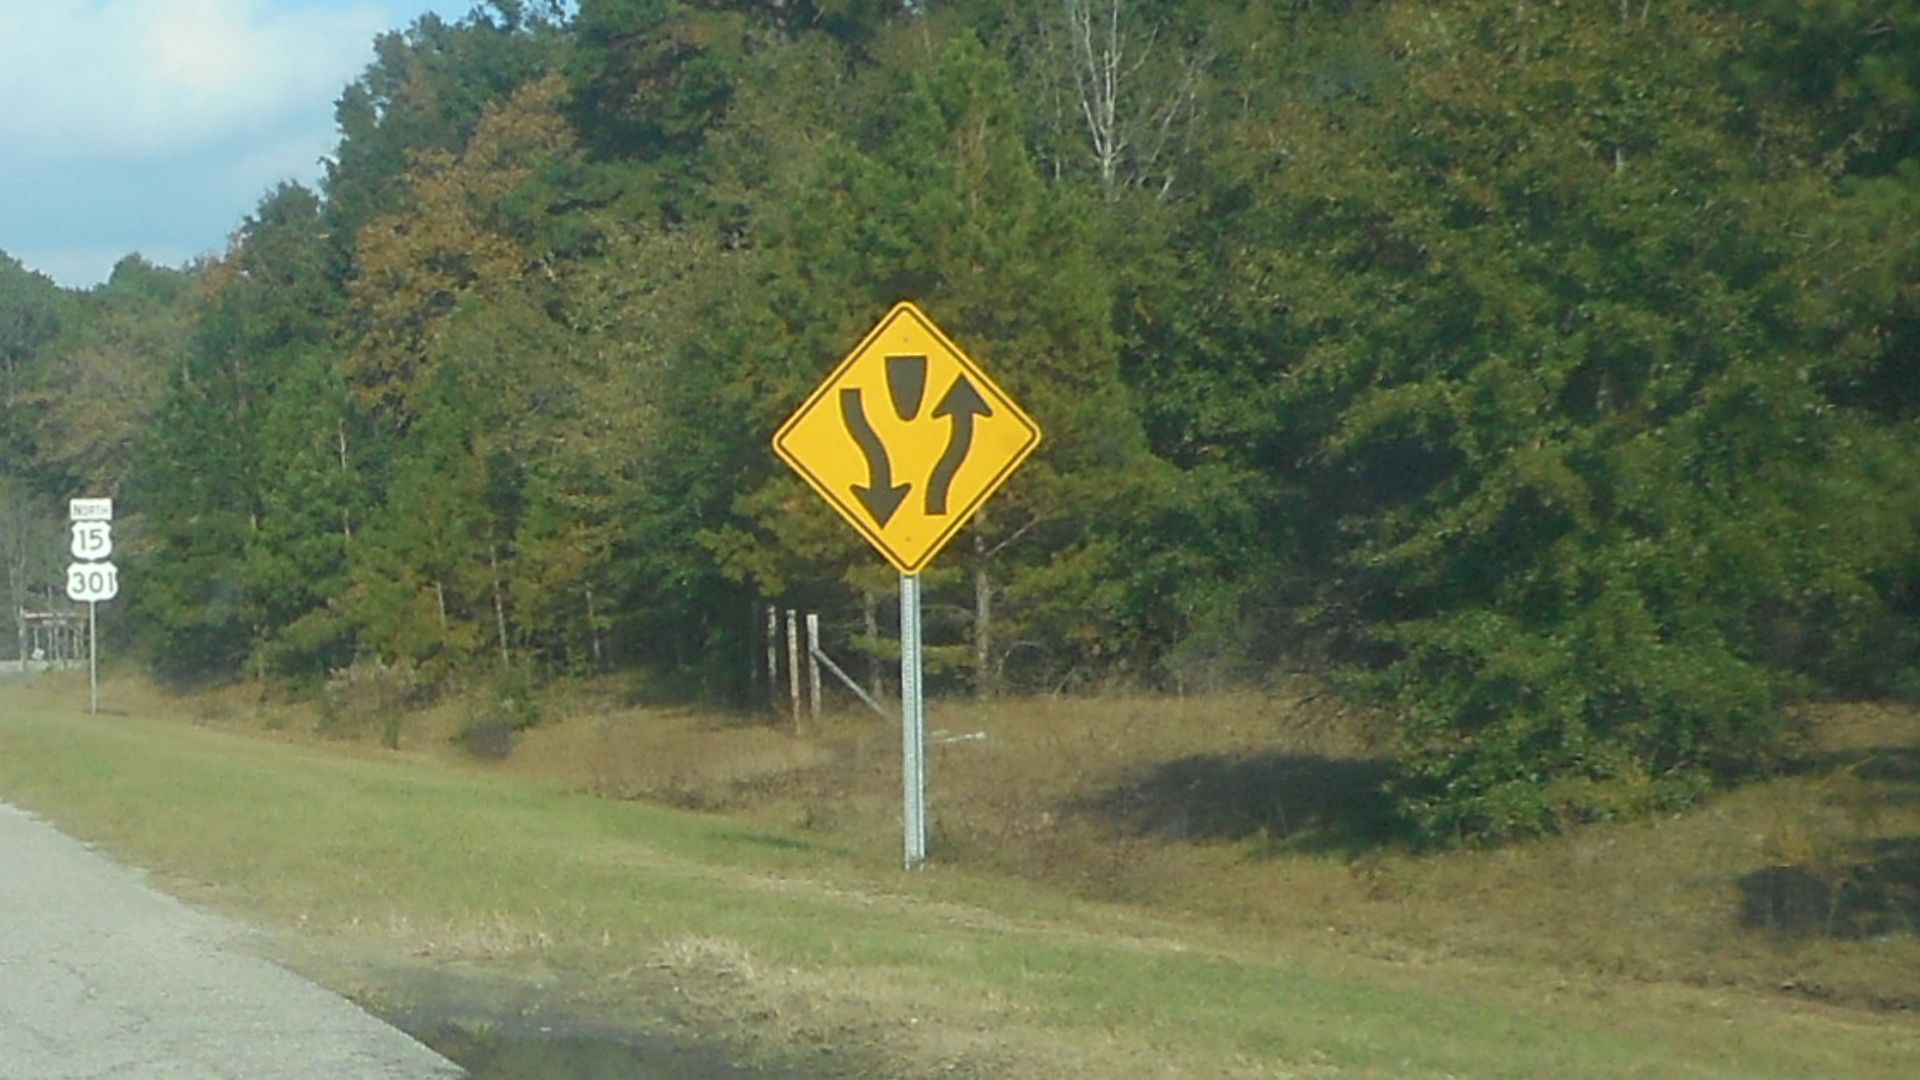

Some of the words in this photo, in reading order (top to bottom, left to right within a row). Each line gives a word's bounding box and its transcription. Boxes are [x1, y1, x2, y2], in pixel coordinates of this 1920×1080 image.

[73, 504, 108, 516] NORTH
[79, 529, 104, 550] 15
[72, 572, 114, 594] 301
